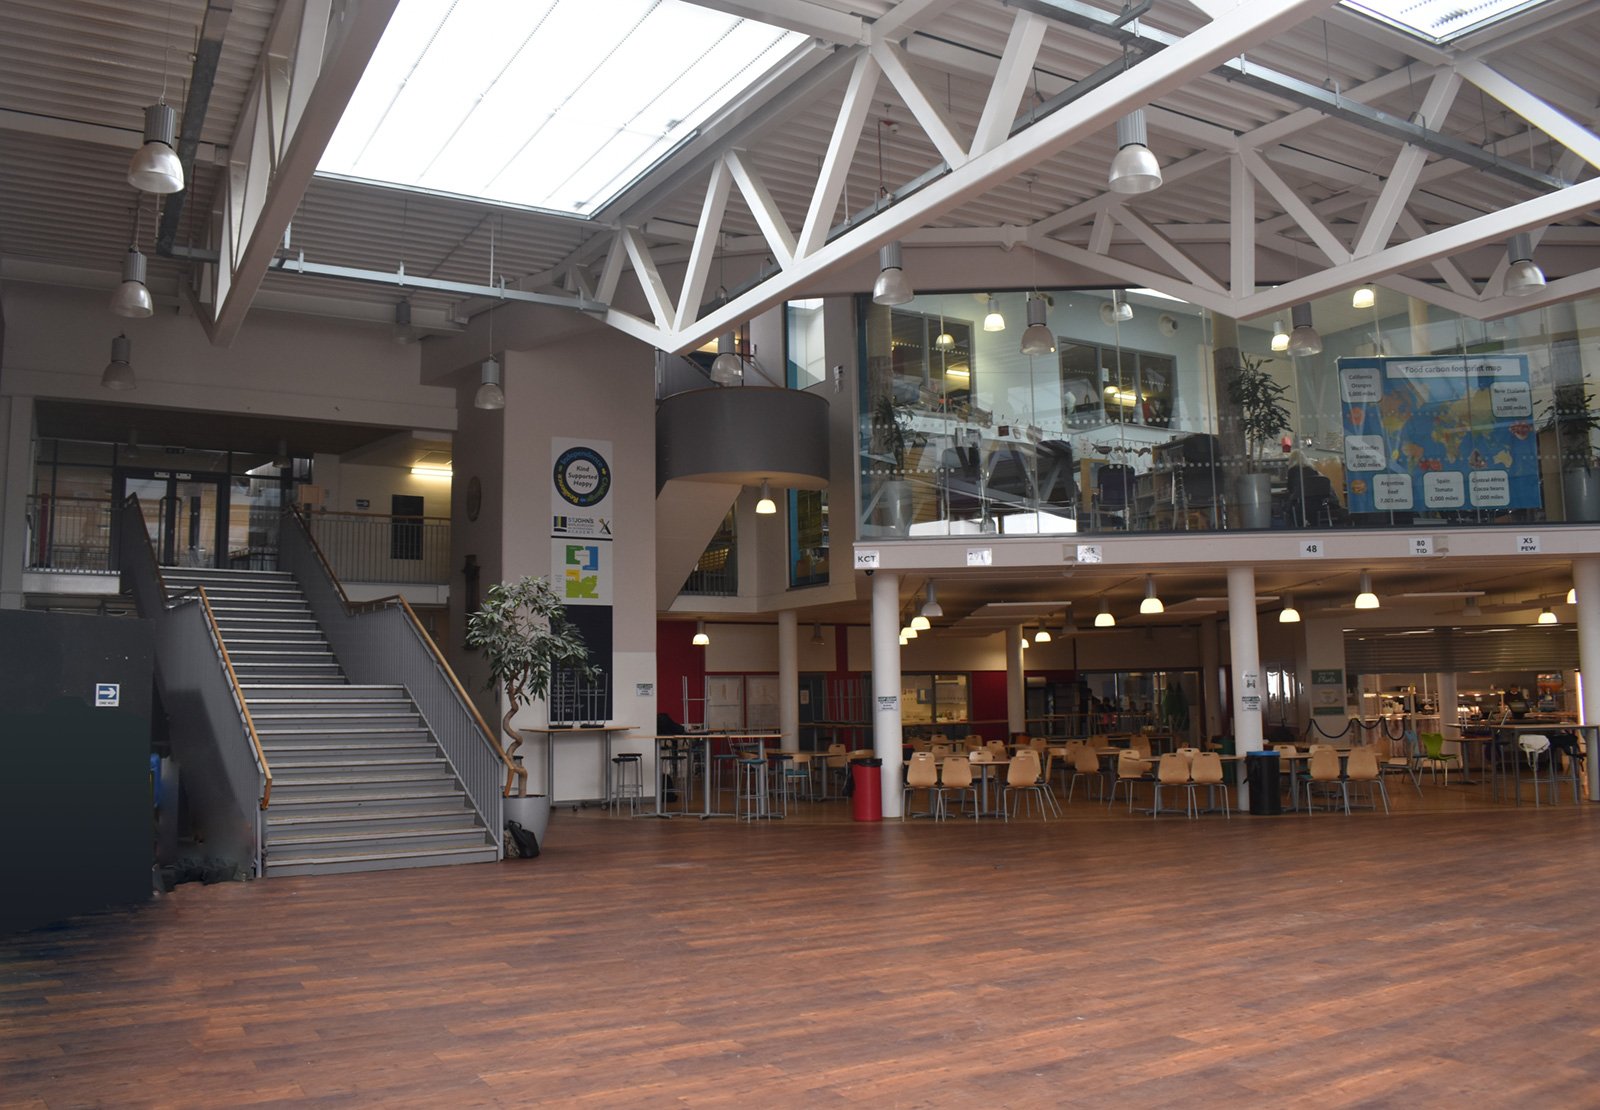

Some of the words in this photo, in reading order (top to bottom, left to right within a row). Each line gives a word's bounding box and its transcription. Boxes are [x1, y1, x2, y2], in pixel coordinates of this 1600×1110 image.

[1405, 365, 1424, 373] Food
[1451, 364, 1484, 373] footprint
[568, 472, 597, 480] Supported
[573, 480, 592, 488] Happy
[1306, 544, 1318, 553] 48
[857, 555, 876, 563] KCT
